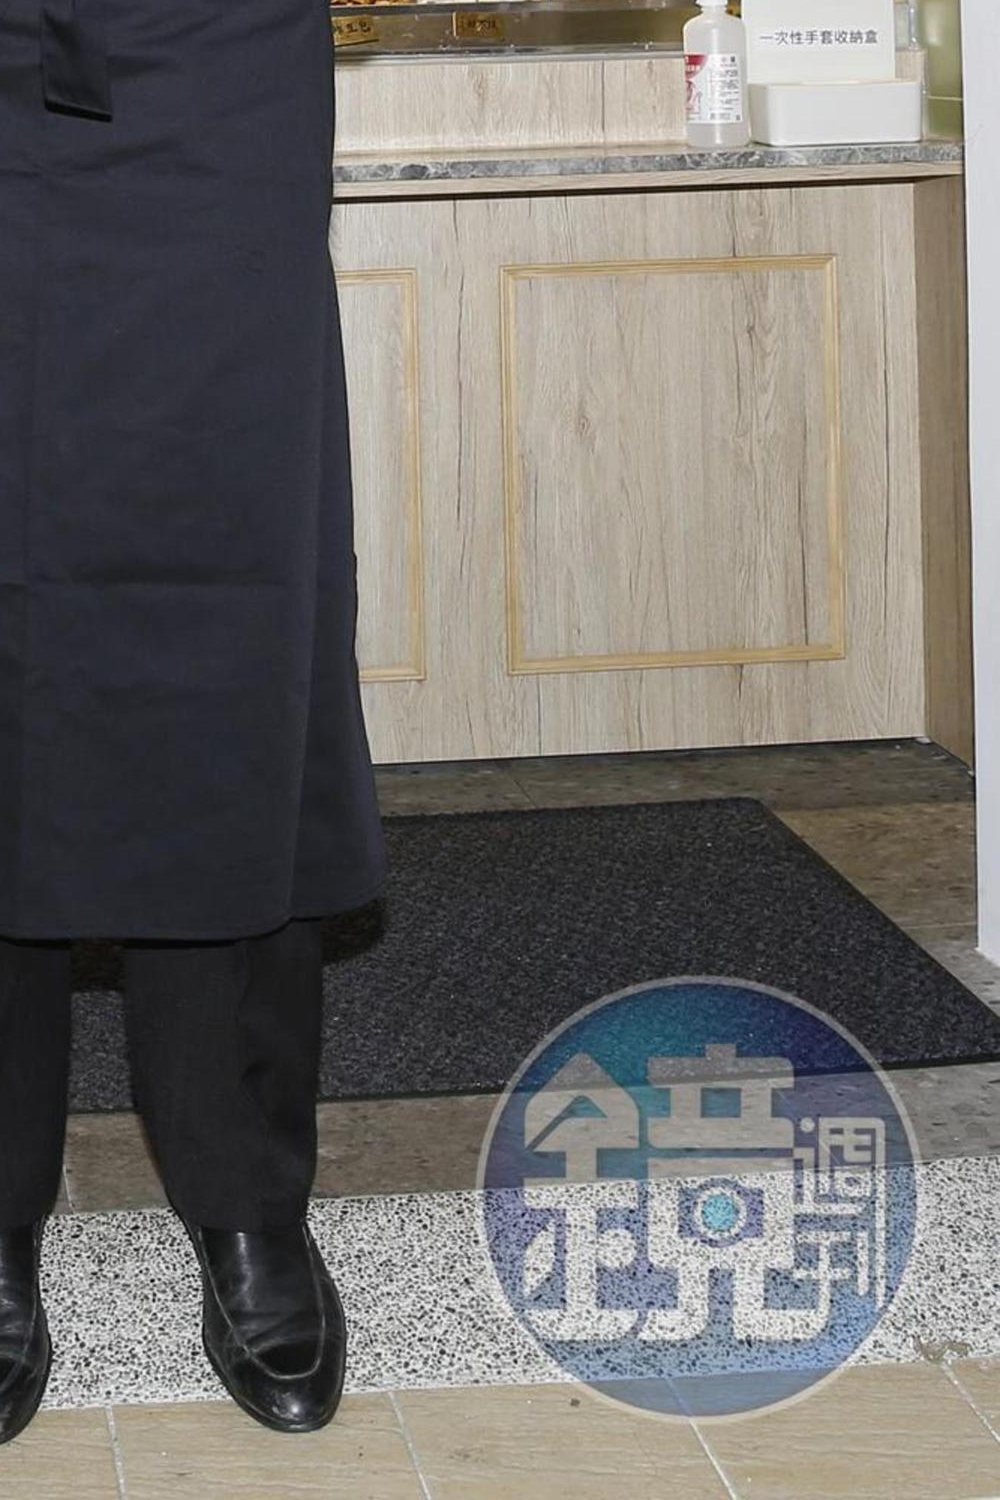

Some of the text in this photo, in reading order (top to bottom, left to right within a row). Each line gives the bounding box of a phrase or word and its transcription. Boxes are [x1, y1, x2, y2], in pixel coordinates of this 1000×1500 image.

[760, 30, 878, 45] 一次性手套收納盒
